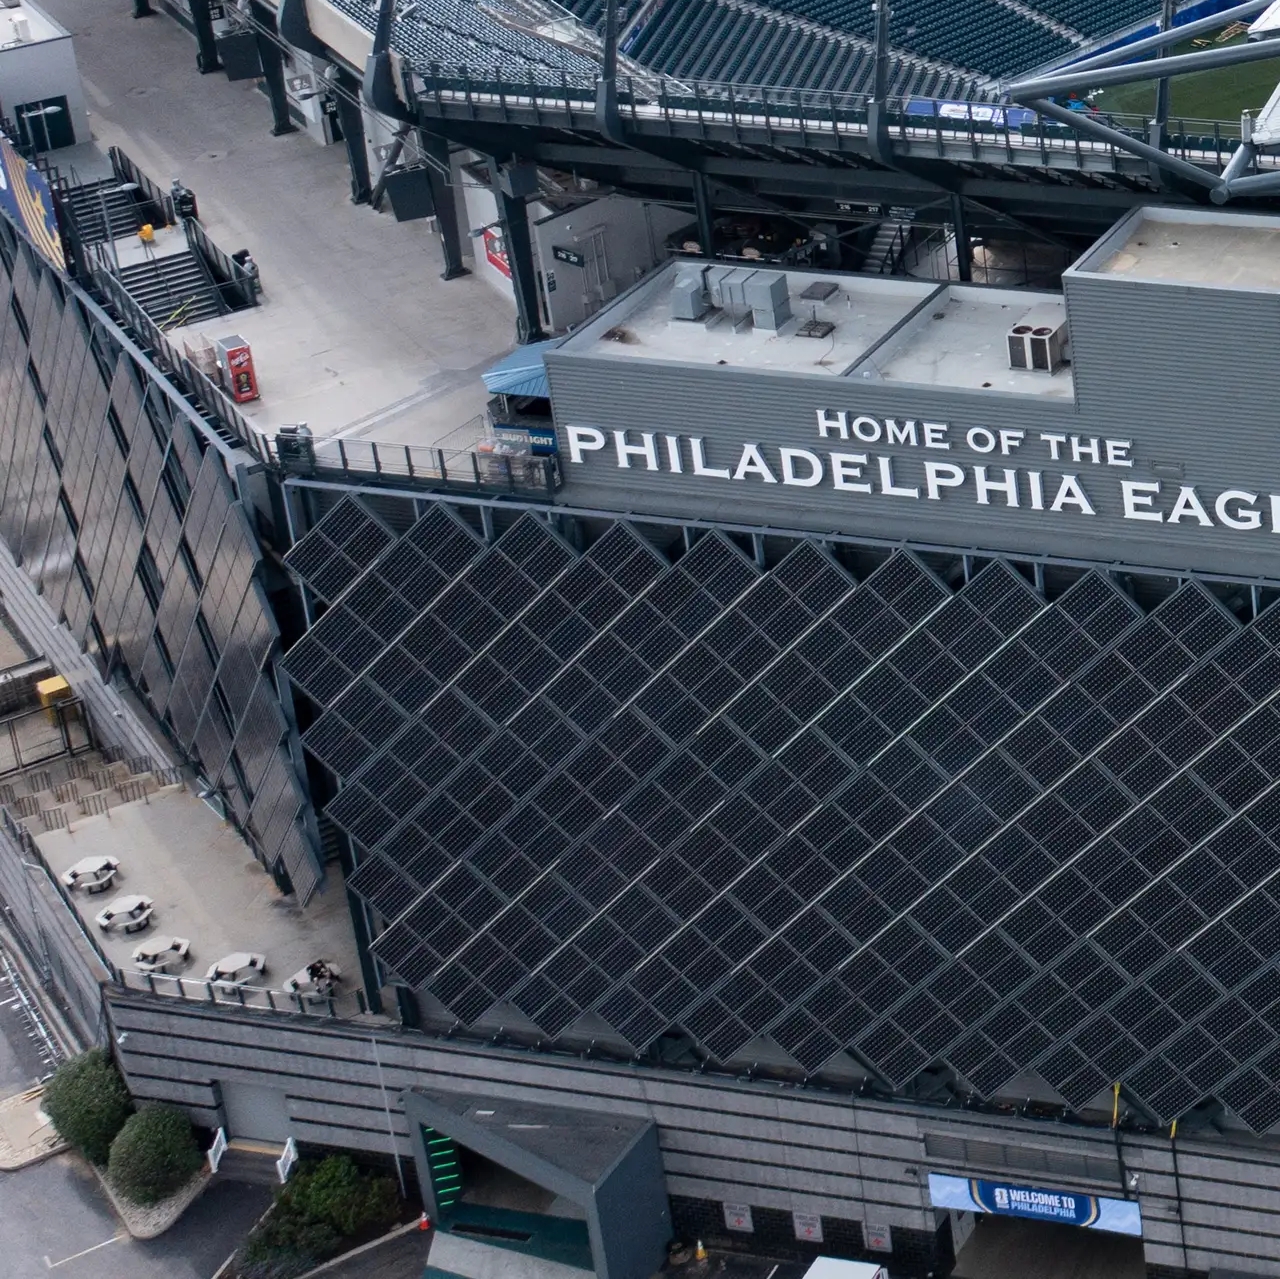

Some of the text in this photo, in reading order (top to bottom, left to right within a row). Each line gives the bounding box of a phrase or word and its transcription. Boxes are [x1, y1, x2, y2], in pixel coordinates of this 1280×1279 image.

[523, 434, 553, 446] LIGHT
[816, 408, 1134, 468] HOME OF THE
[565, 425, 1096, 516] PHILADELPHIA
[1008, 1189, 1076, 1209] WELCOME TO
[1010, 1201, 1077, 1219] PHILADELPHIA
